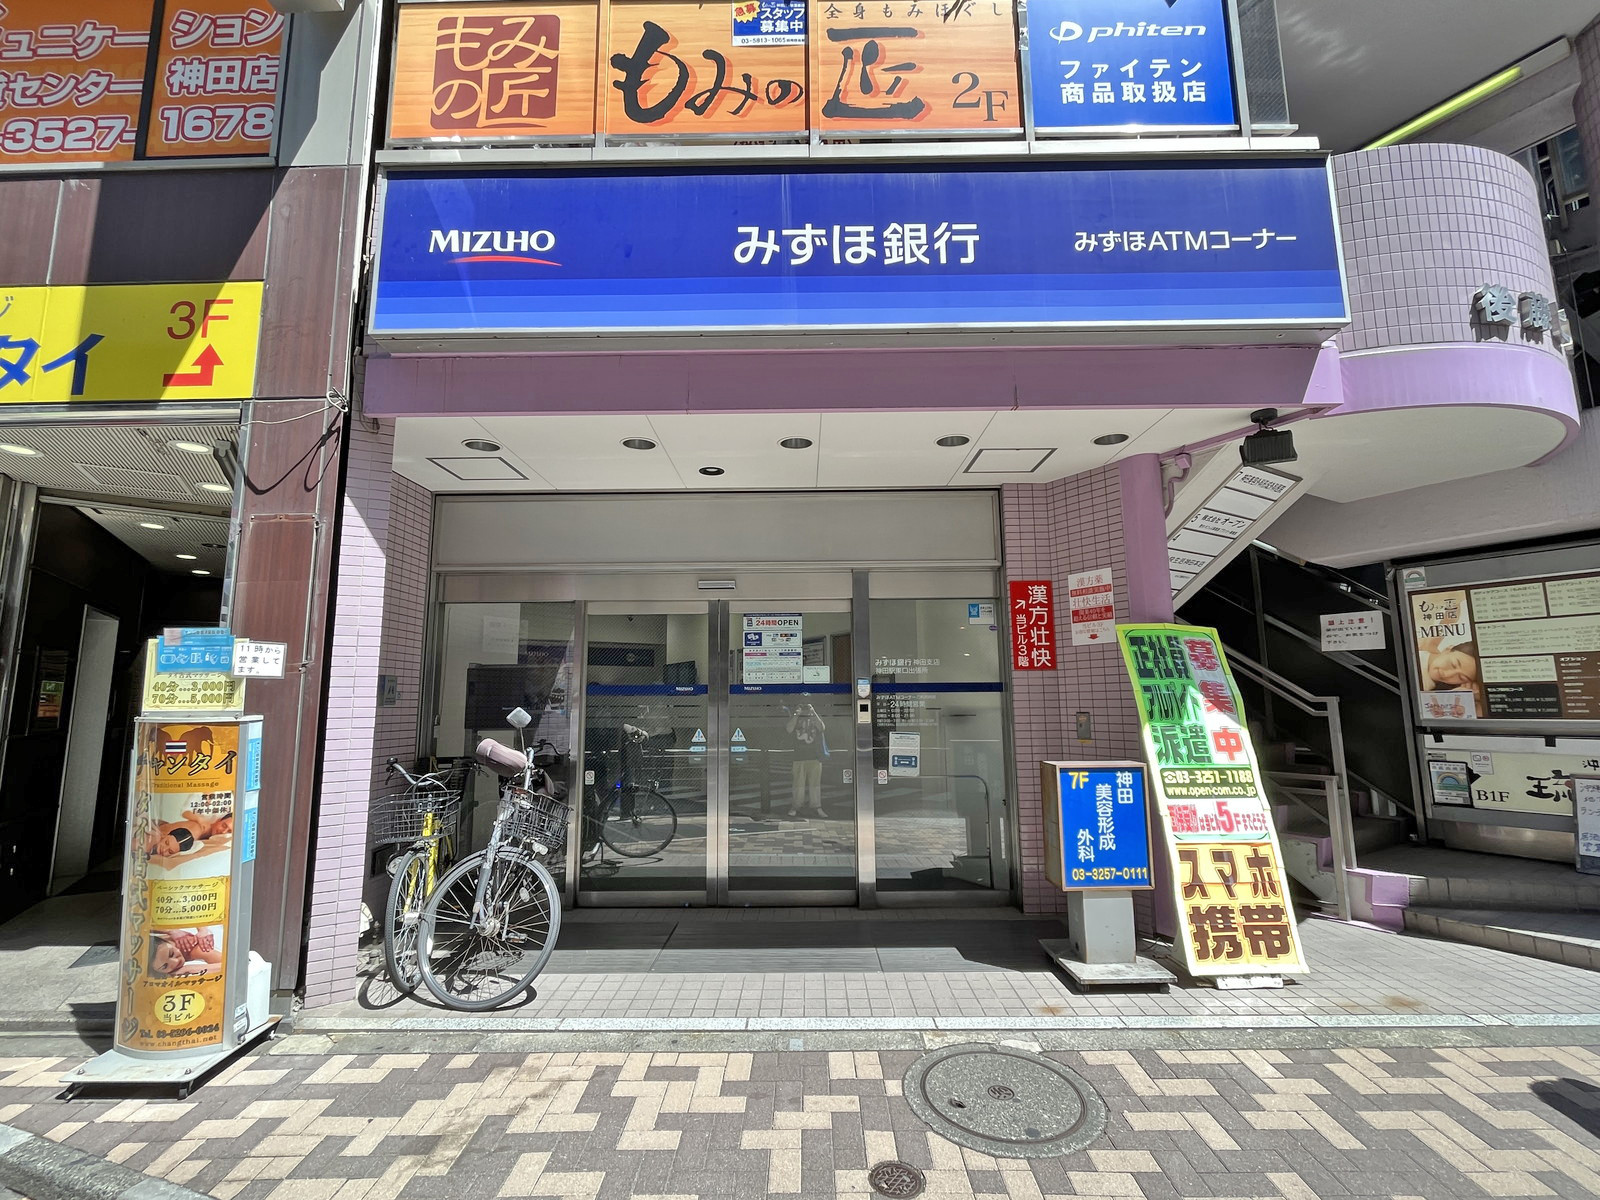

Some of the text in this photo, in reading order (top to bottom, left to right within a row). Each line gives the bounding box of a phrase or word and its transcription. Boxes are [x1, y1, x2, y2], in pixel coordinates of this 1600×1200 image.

[760, 8, 805, 20] スタッフ
[0, 9, 284, 62] ュニケー ション
[760, 20, 804, 33] 募集中
[1087, 22, 1207, 43] phiten
[166, 55, 281, 96] 神田店
[1059, 59, 1203, 79] ファイテン
[951, 71, 1009, 122] 2F
[1059, 81, 1207, 104] 商品取扱店
[159, 104, 275, 143] 1678
[428, 229, 557, 253] MIZUHO
[733, 222, 981, 266] みずほ銀行
[1074, 228, 1298, 252] みずほATMコーナー
[166, 298, 234, 341] 3F
[755, 619, 800, 627] 24時間OPEN
[1027, 584, 1052, 668] 漢方壮快
[1419, 623, 1467, 638] MENU
[240, 645, 282, 655] 11時から
[1015, 613, 1030, 667] 当ビル3階
[238, 655, 280, 665] 営業して
[1183, 638, 1243, 762] 募集中
[1151, 724, 1213, 765] 派遣
[1068, 771, 1090, 790] 7F
[1115, 771, 1134, 804] 神田
[1475, 789, 1510, 803] B1F
[1095, 783, 1117, 851] 美容形成
[1077, 828, 1096, 863] 外科
[1071, 867, 1149, 881] 03-3257-0111
[1178, 847, 1281, 900] スマホ
[1188, 903, 1292, 961] 携帯
[162, 993, 197, 1013] 3F
[162, 1012, 195, 1023] 当ビル
